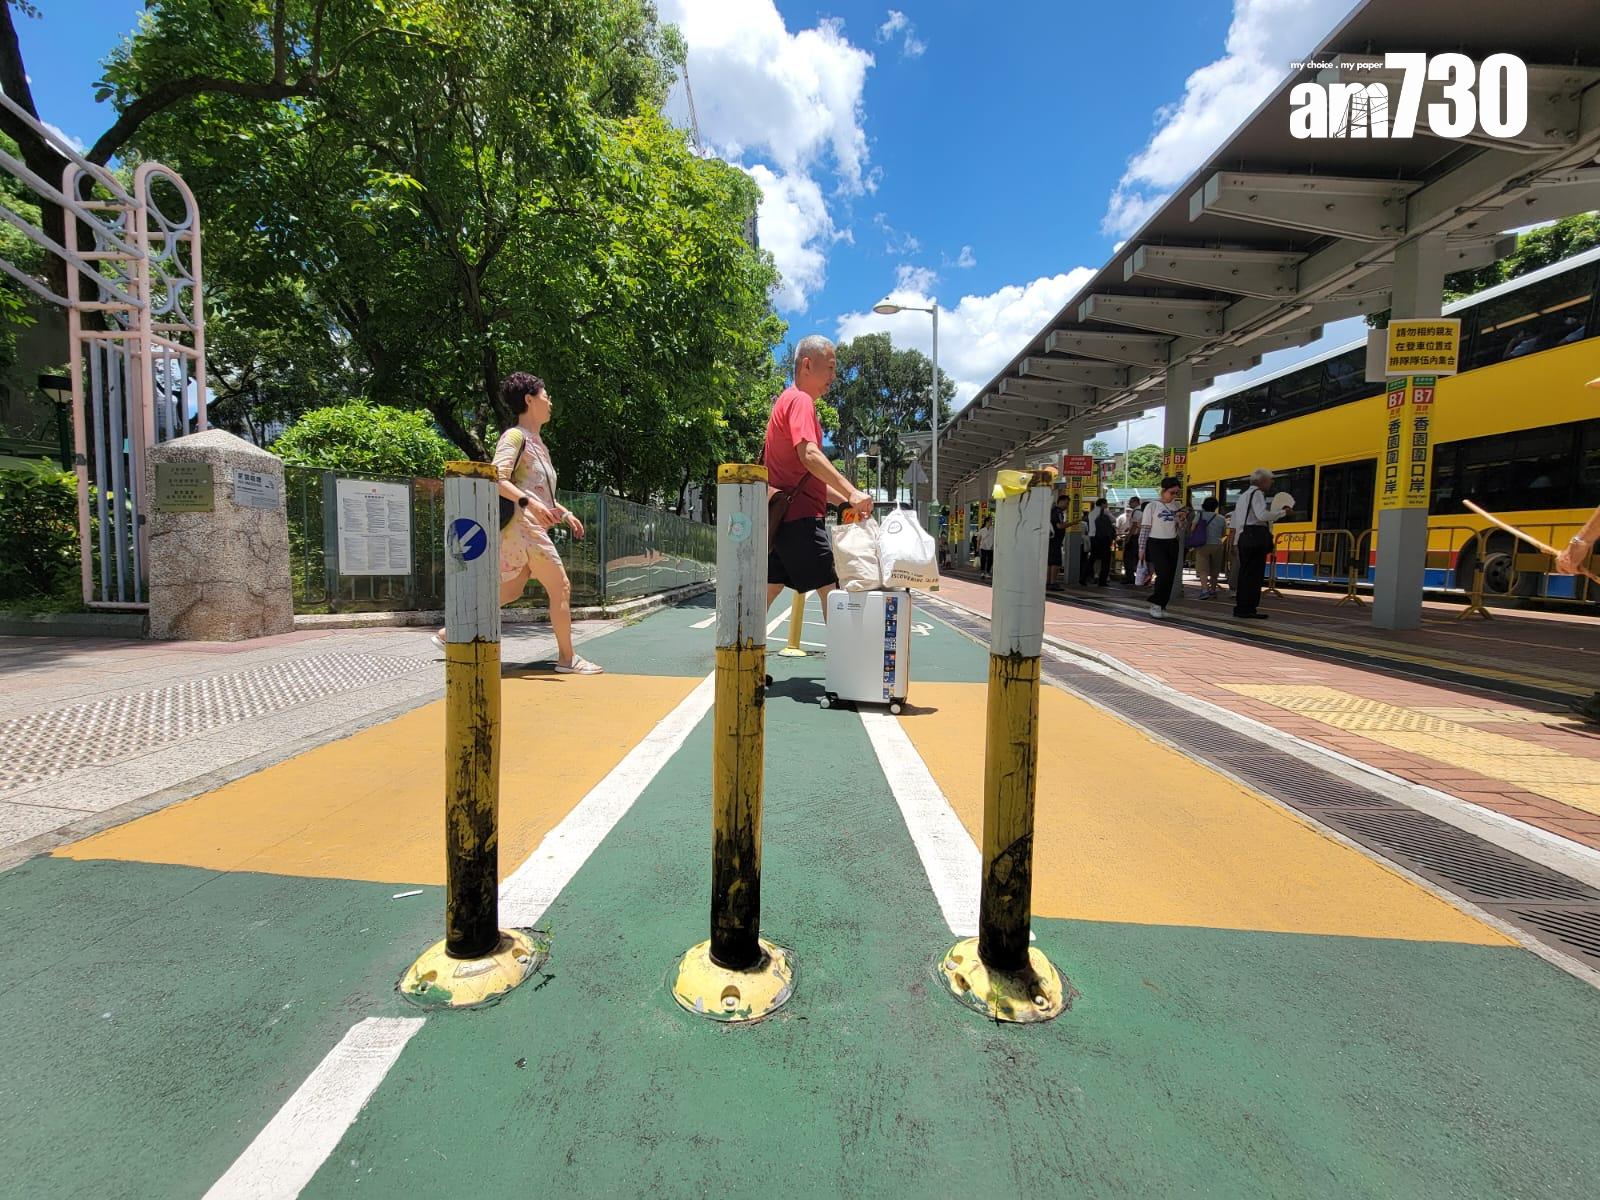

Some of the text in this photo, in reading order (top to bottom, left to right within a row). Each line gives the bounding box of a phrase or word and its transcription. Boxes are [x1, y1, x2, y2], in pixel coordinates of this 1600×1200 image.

[1396, 326, 1453, 338] 請勿相約親友
[1395, 341, 1452, 351] 在登車位置或
[1389, 355, 1455, 366] 排隊隊伍內集合
[1389, 392, 1404, 407] B7
[1414, 388, 1433, 402] B7
[1175, 455, 1186, 464] B7
[1385, 419, 1401, 494] 香園圍口岸
[1410, 417, 1429, 493] 香園圍口岸
